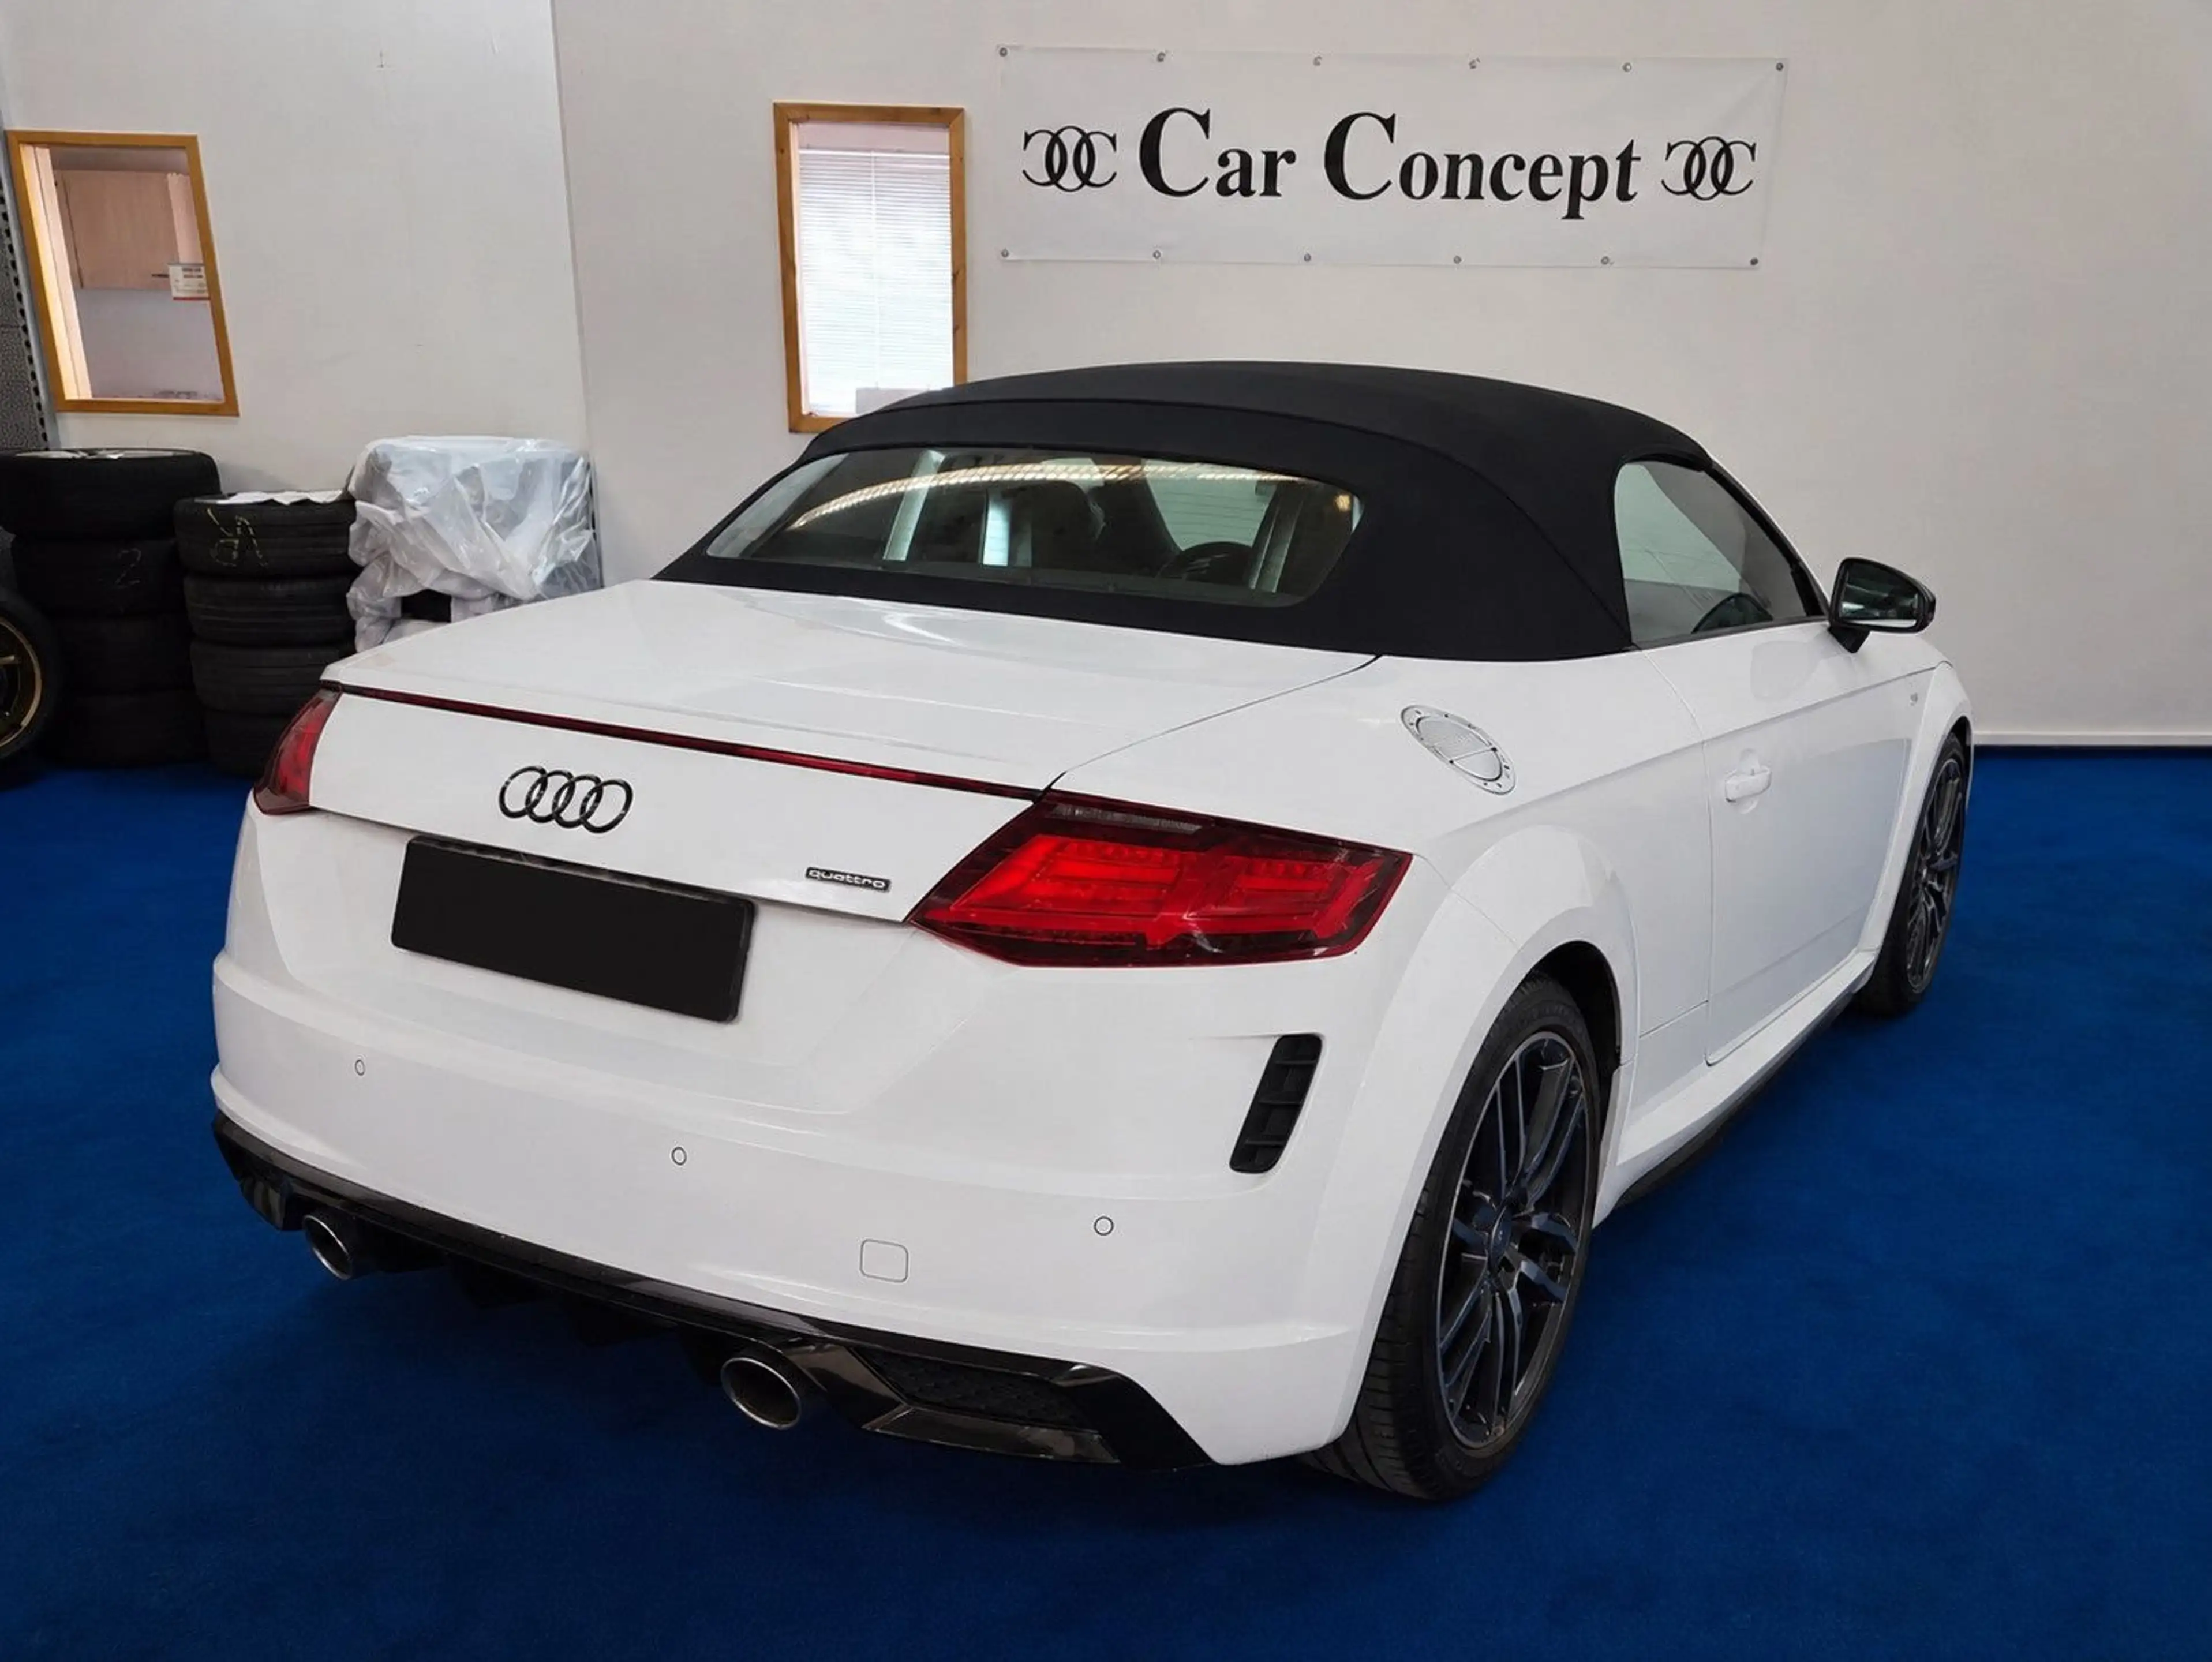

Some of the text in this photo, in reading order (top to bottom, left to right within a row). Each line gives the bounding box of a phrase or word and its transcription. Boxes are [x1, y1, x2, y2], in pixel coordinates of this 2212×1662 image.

[1140, 108, 1296, 200] Car
[1324, 113, 1641, 219] Concept
[808, 869, 887, 889] quattro
